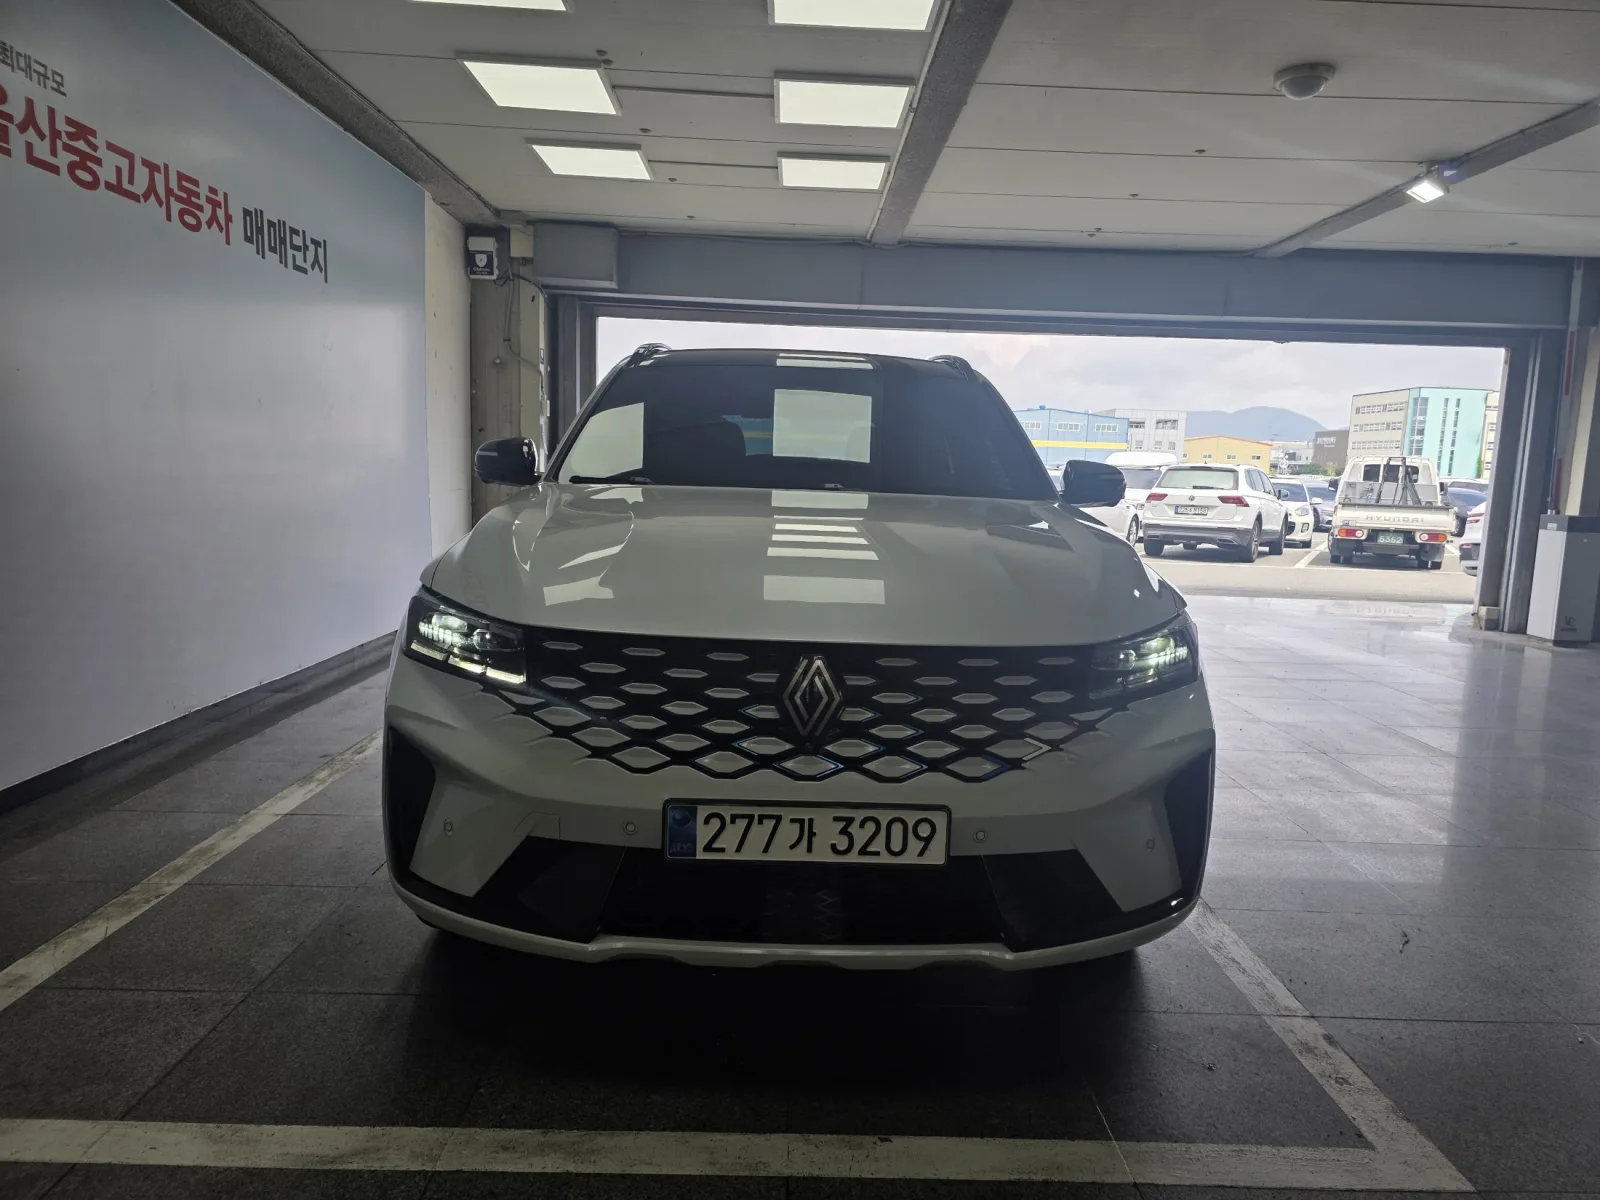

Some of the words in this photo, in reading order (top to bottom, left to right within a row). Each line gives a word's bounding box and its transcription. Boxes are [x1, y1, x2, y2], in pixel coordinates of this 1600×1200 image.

[0, 40, 67, 97] 최대규모
[242, 206, 328, 284] 매매단지
[1366, 515, 1424, 523] HYUNDAI
[702, 811, 817, 853] 277가
[830, 814, 937, 858] 3209
